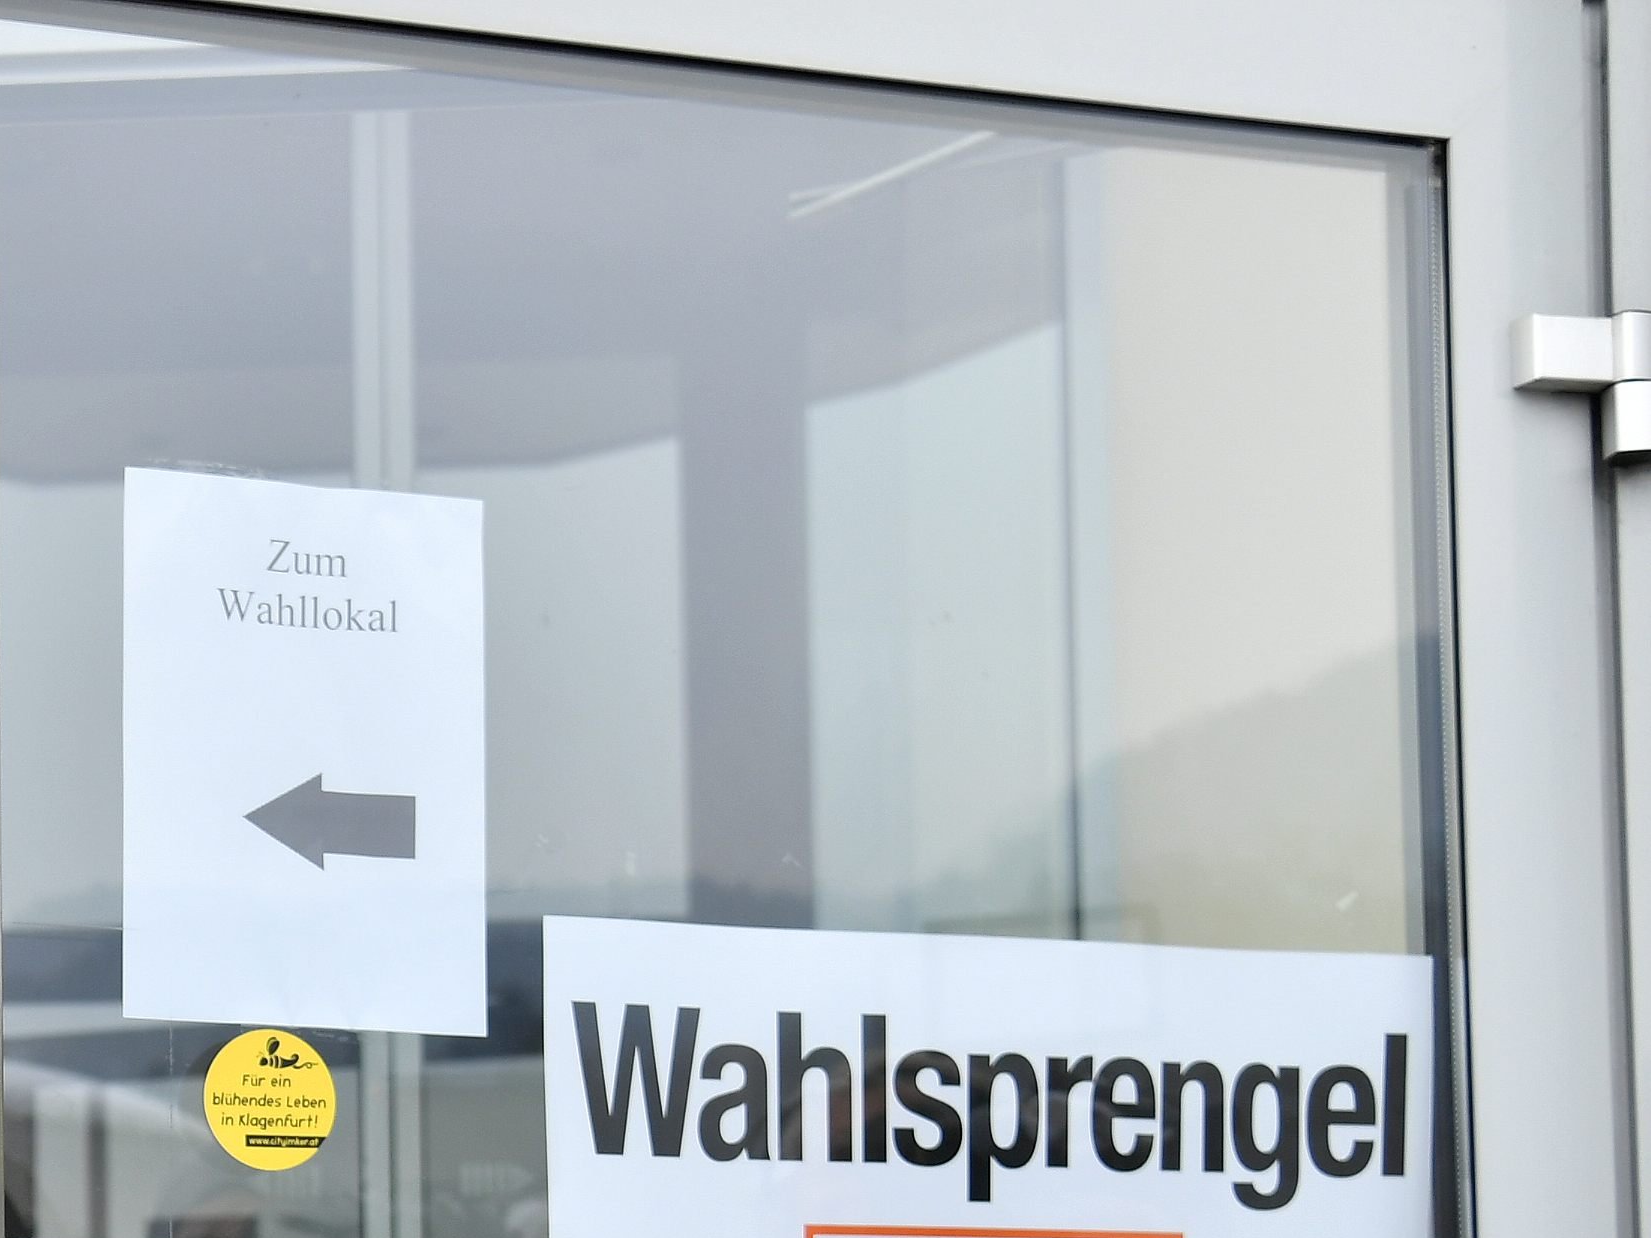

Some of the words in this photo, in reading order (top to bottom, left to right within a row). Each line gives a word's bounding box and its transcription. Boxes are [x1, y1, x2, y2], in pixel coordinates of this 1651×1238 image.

[267, 539, 347, 577] Zum
[217, 588, 398, 632] Wahllokal
[242, 1074, 265, 1087] Für
[271, 1074, 291, 1087] ein
[212, 1092, 282, 1107] blühendes
[286, 1095, 327, 1108] Leben
[571, 1000, 1408, 1211] Wahlsprengel
[221, 1112, 234, 1126] in
[238, 1113, 318, 1130] Klagenfurt!
[248, 1137, 319, 1147] www.cityimker.at
